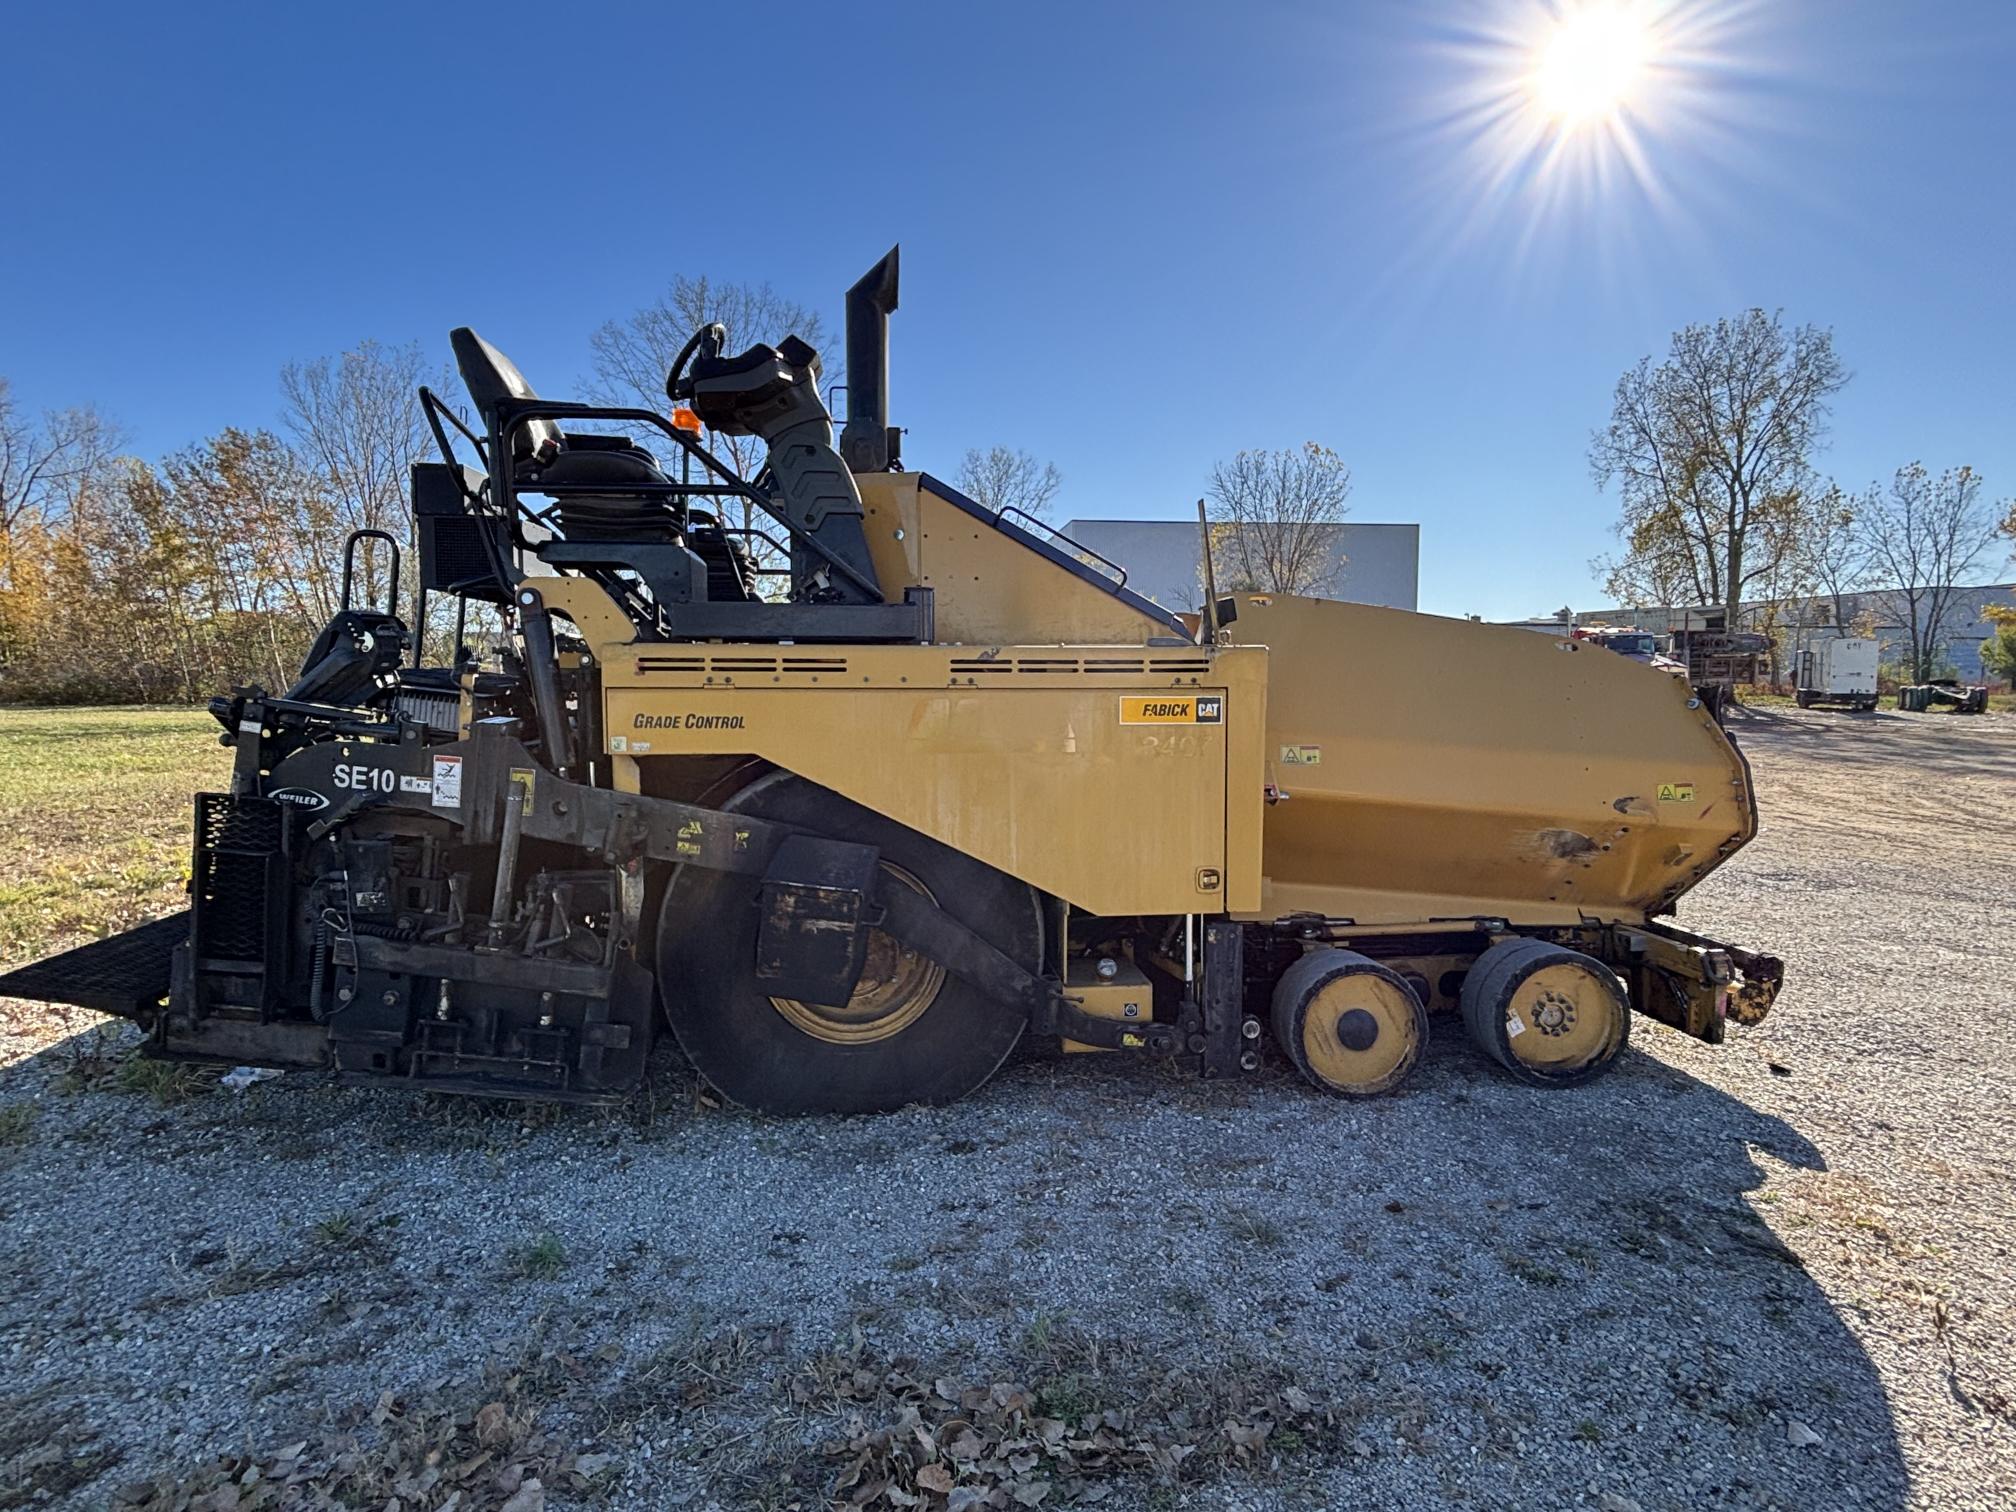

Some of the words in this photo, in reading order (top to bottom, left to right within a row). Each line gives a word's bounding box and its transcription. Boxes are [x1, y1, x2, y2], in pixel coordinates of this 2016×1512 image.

[1142, 704, 1190, 717] FABICK
[1198, 704, 1220, 717] CAT
[333, 764, 396, 793] SE10
[279, 793, 319, 806] WEILER
